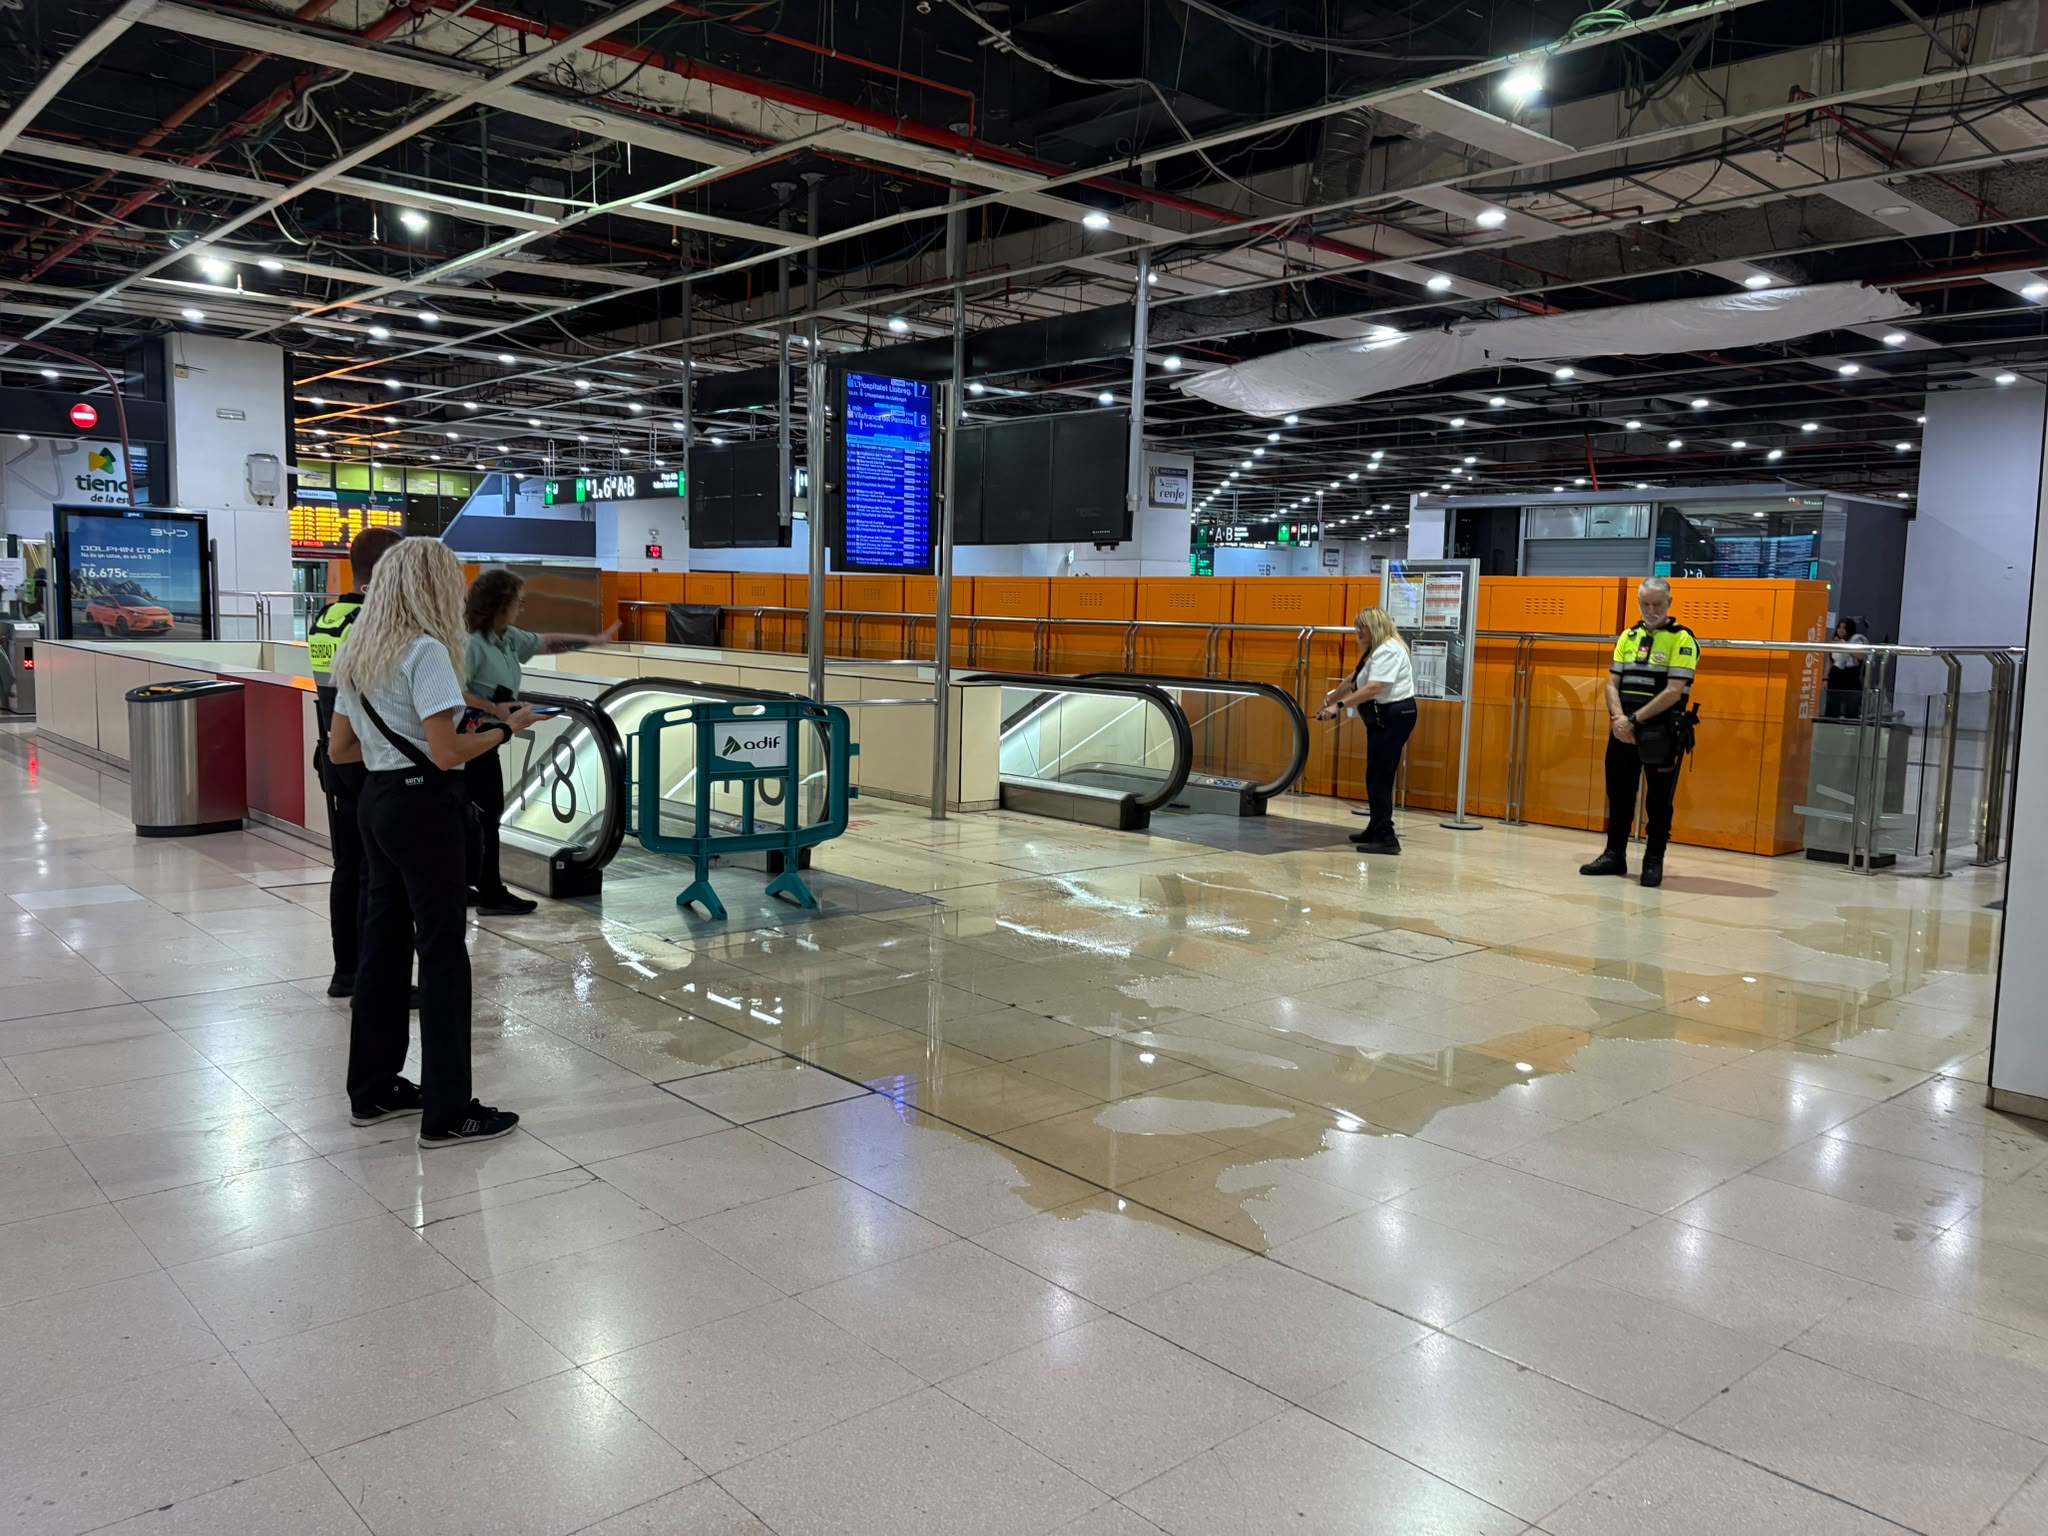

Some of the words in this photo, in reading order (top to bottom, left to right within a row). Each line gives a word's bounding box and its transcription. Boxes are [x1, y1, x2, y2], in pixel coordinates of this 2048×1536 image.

[920, 384, 927, 396] 7
[920, 414, 927, 426] 8
[90, 493, 103, 502] de
[105, 494, 114, 503] la
[1159, 487, 1184, 502] renfe
[150, 528, 188, 537] BYD
[80, 545, 134, 553] DOLPHIN
[1798, 626, 1816, 719] Bitlles
[743, 735, 781, 750] adif
